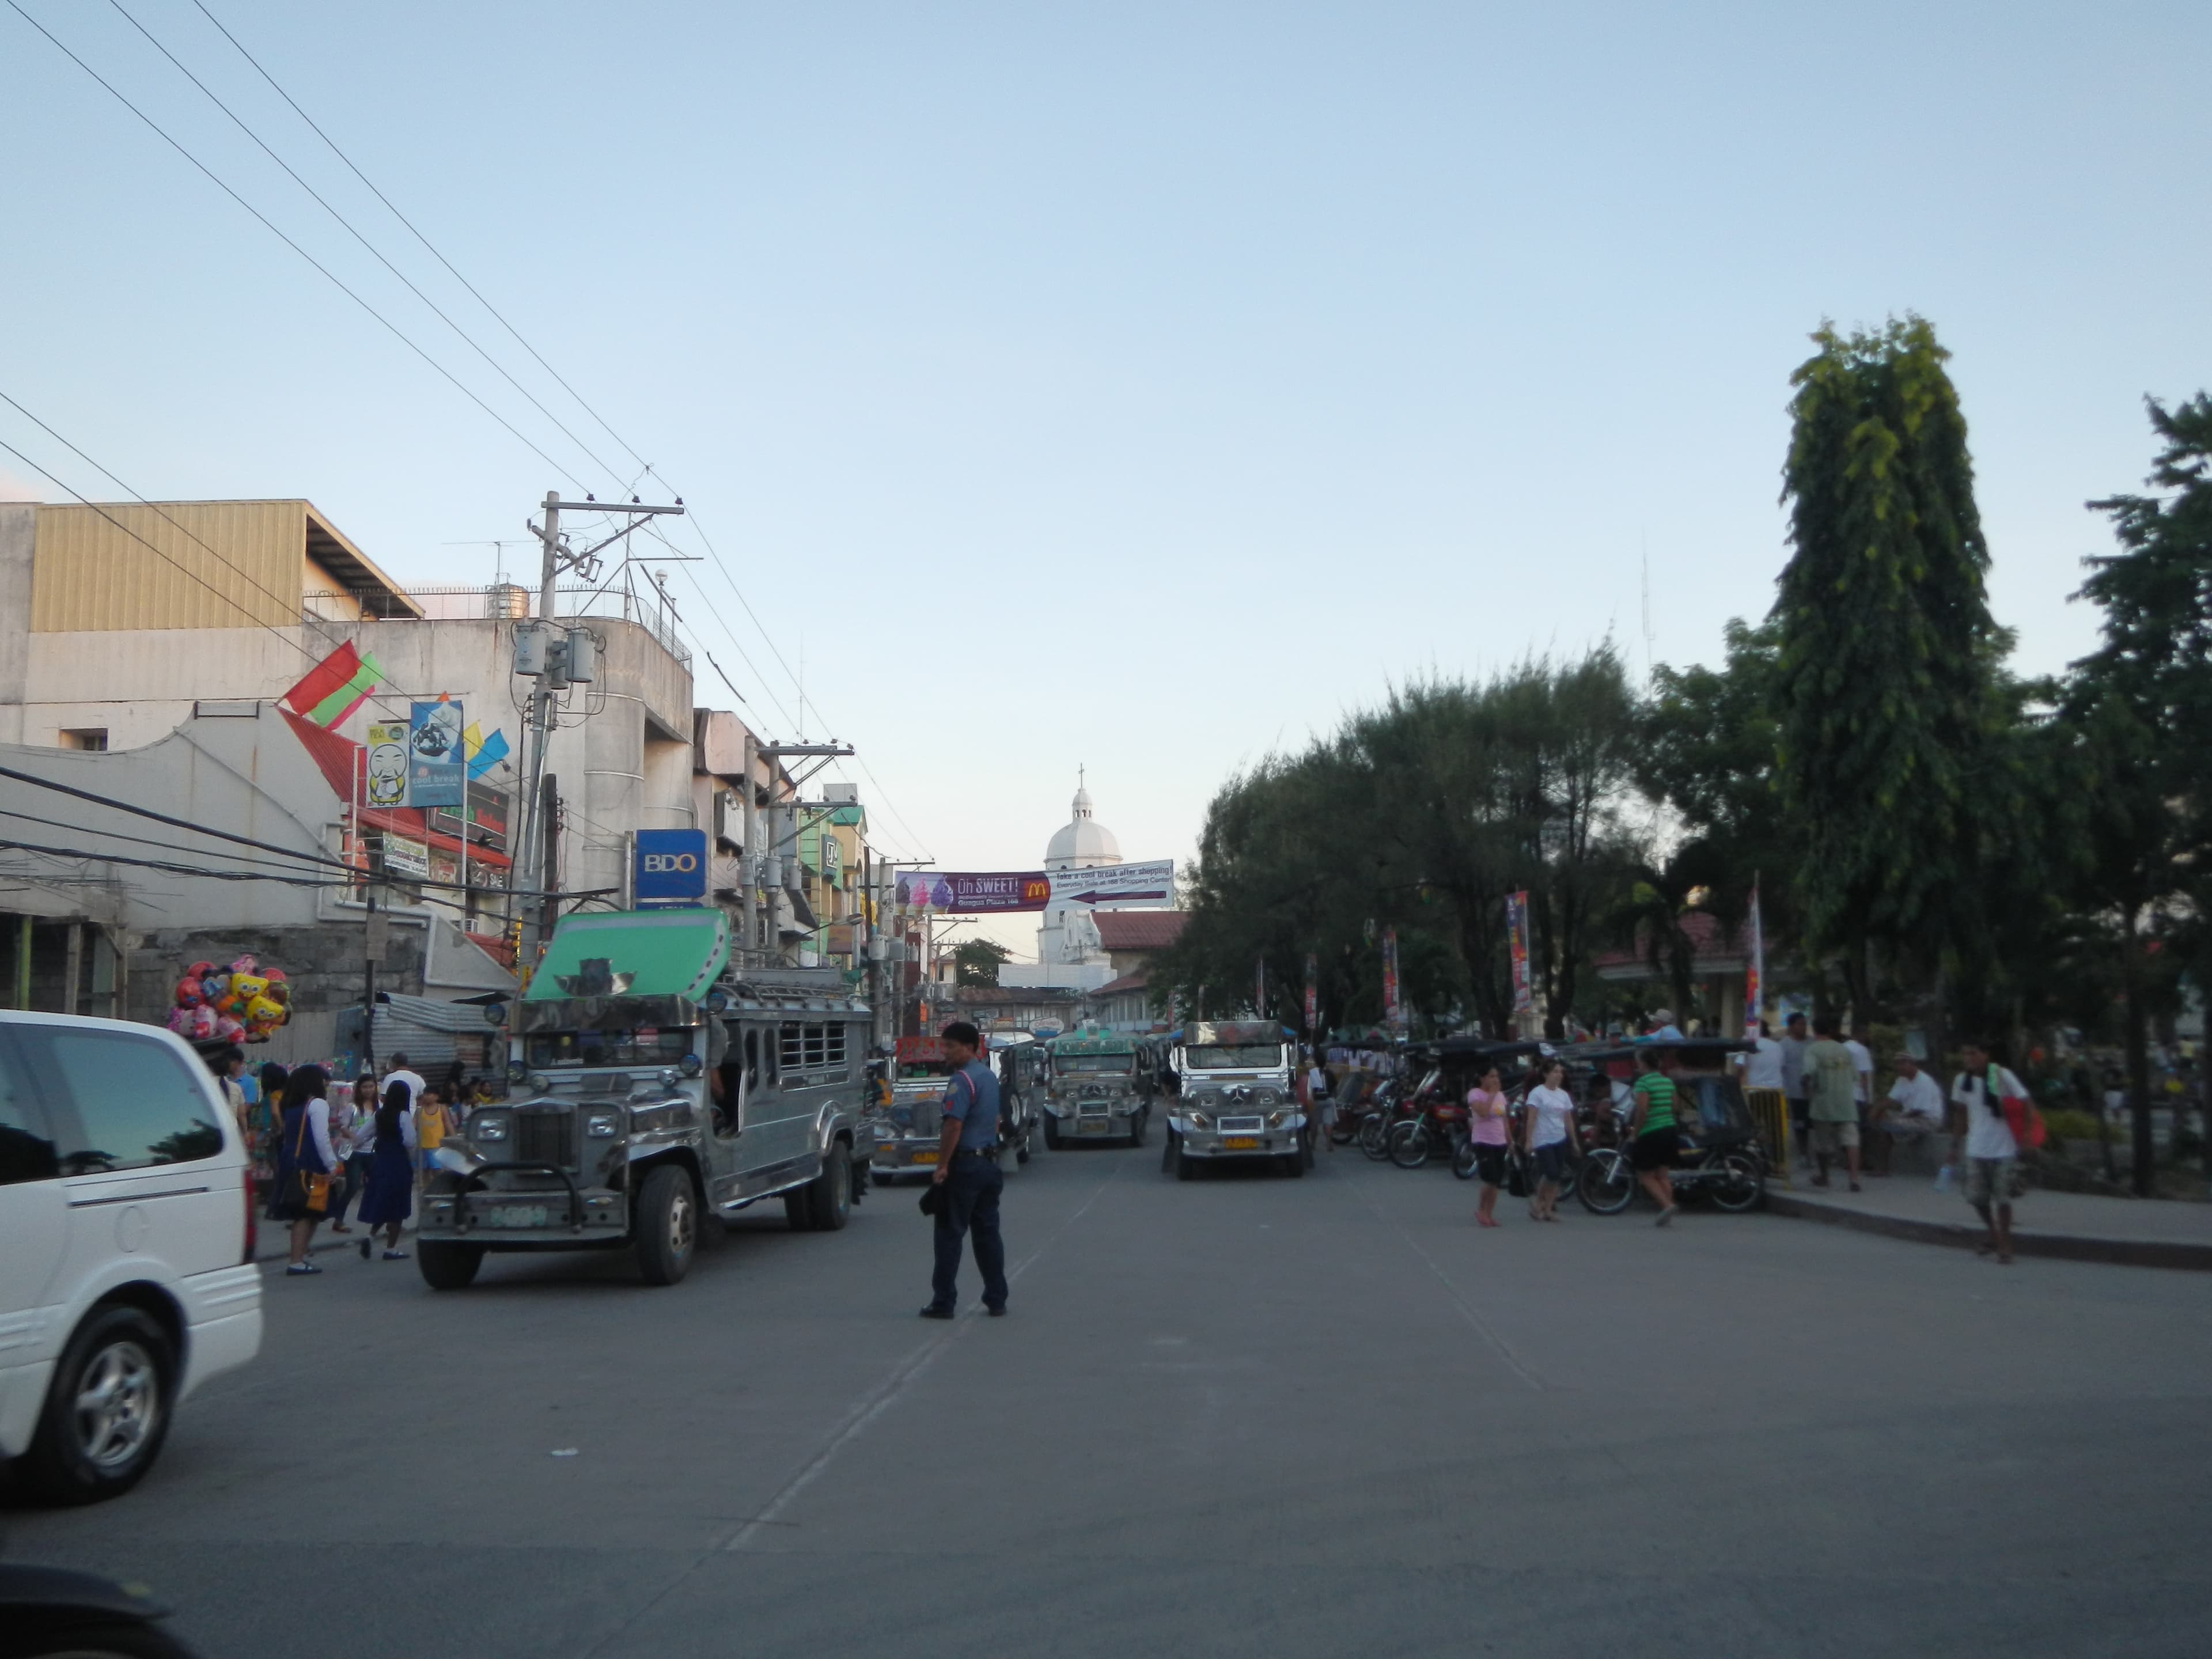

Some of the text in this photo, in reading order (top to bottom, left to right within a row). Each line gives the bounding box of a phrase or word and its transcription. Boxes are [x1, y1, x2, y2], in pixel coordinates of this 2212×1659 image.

[645, 854, 696, 872] BDO
[1097, 869, 1117, 878] break
[1119, 868, 1135, 876] after
[1138, 865, 1172, 876] shopping!
[958, 877, 1018, 895] Oh SWEET!
